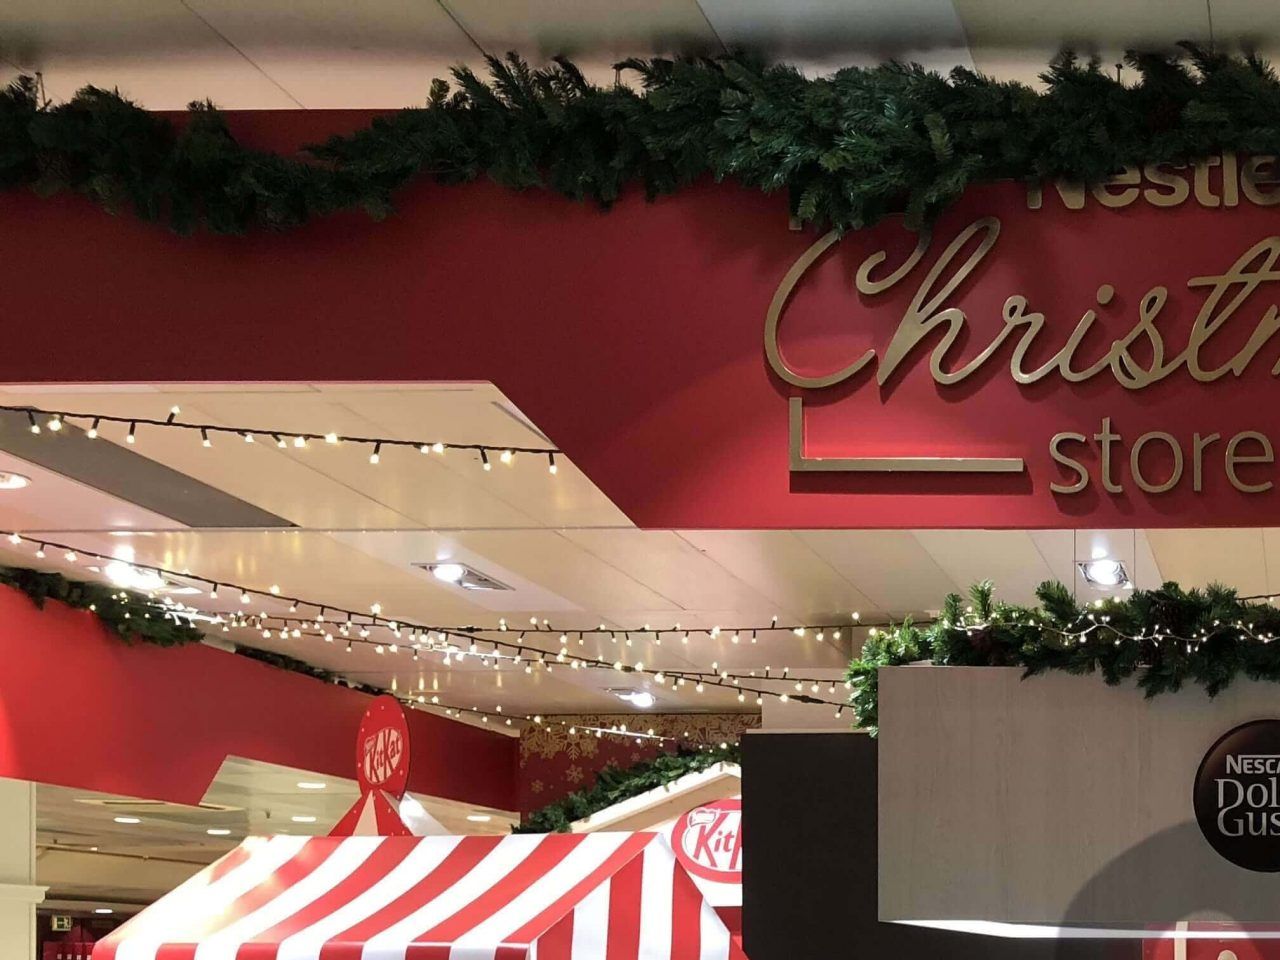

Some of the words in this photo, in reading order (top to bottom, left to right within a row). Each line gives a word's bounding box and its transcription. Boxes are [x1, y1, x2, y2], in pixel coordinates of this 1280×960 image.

[1048, 417, 1275, 495] store
[370, 728, 400, 783] KitKat
[692, 811, 742, 871] Kit
